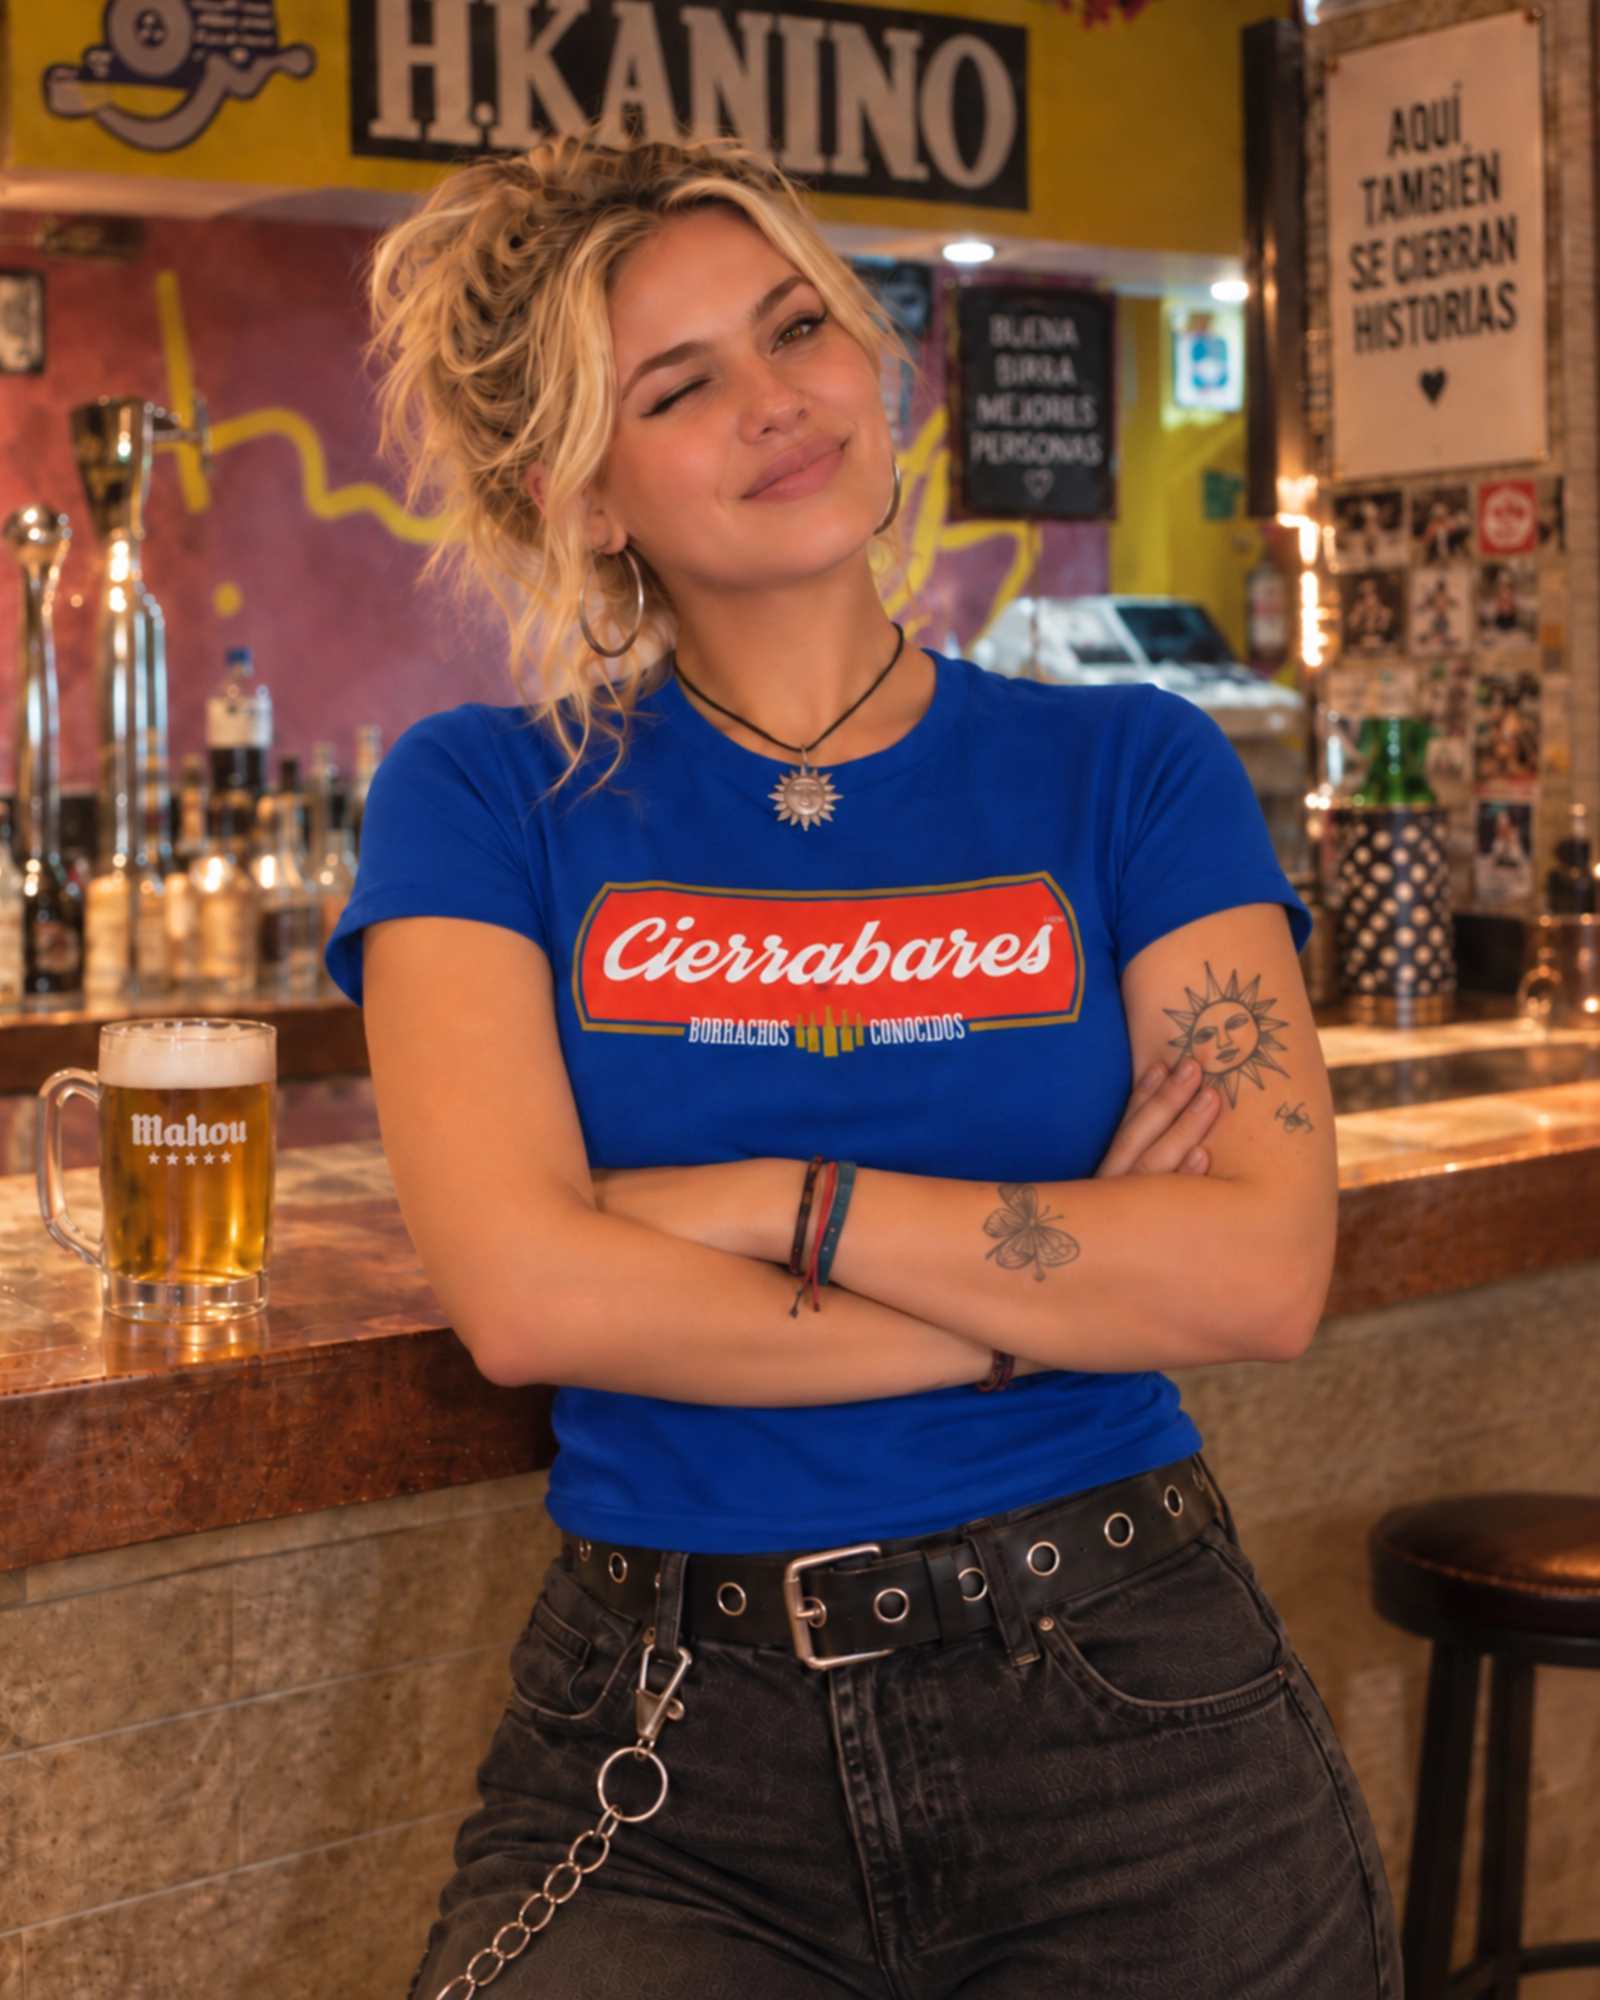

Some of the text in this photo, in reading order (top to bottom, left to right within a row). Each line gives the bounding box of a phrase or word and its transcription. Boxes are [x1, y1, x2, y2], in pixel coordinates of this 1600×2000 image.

[1388, 82, 1462, 158] AQUÍ
[1360, 145, 1501, 227] TAMBIÉN
[1350, 214, 1517, 290] SE CIERRAN
[989, 314, 1079, 348] BUENA
[1354, 281, 1517, 353] HISTORIAS
[994, 353, 1076, 388] BIRRA
[976, 393, 1097, 428] MEJORES
[970, 430, 1103, 467] PERSONAS
[603, 916, 1053, 986] Cierrabares
[688, 1016, 790, 1046] BORRACHOS
[870, 1013, 965, 1045] CONOCIDOS
[130, 1113, 248, 1147] Mahou
